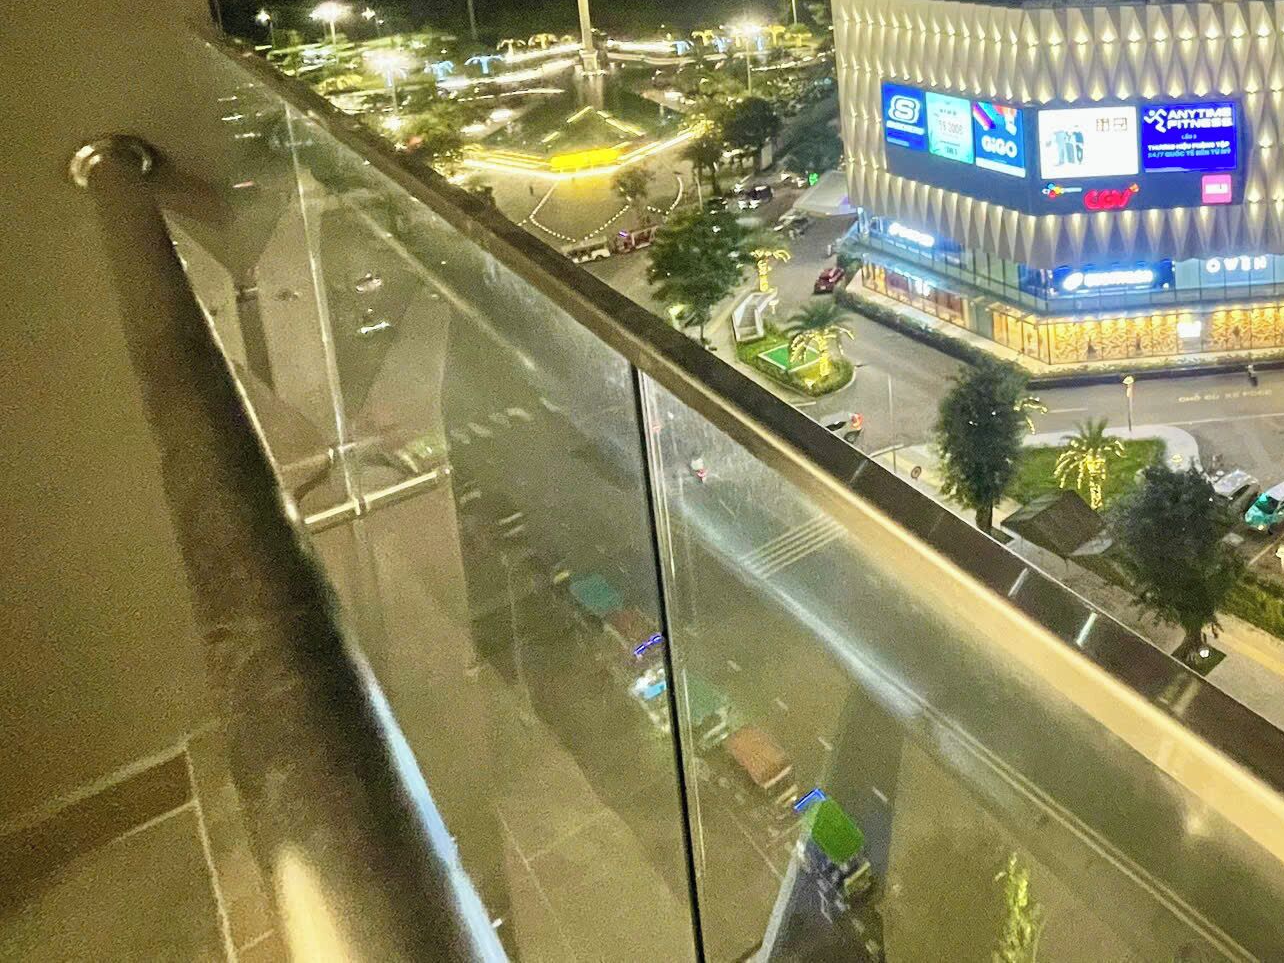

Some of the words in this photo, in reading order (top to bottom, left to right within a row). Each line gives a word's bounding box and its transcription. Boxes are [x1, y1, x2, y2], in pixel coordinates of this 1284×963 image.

[1168, 107, 1232, 119] ANYTIME
[1167, 117, 1233, 129] FITNESS
[1084, 188, 1134, 211] CGV
[1205, 254, 1268, 274] OWEN
